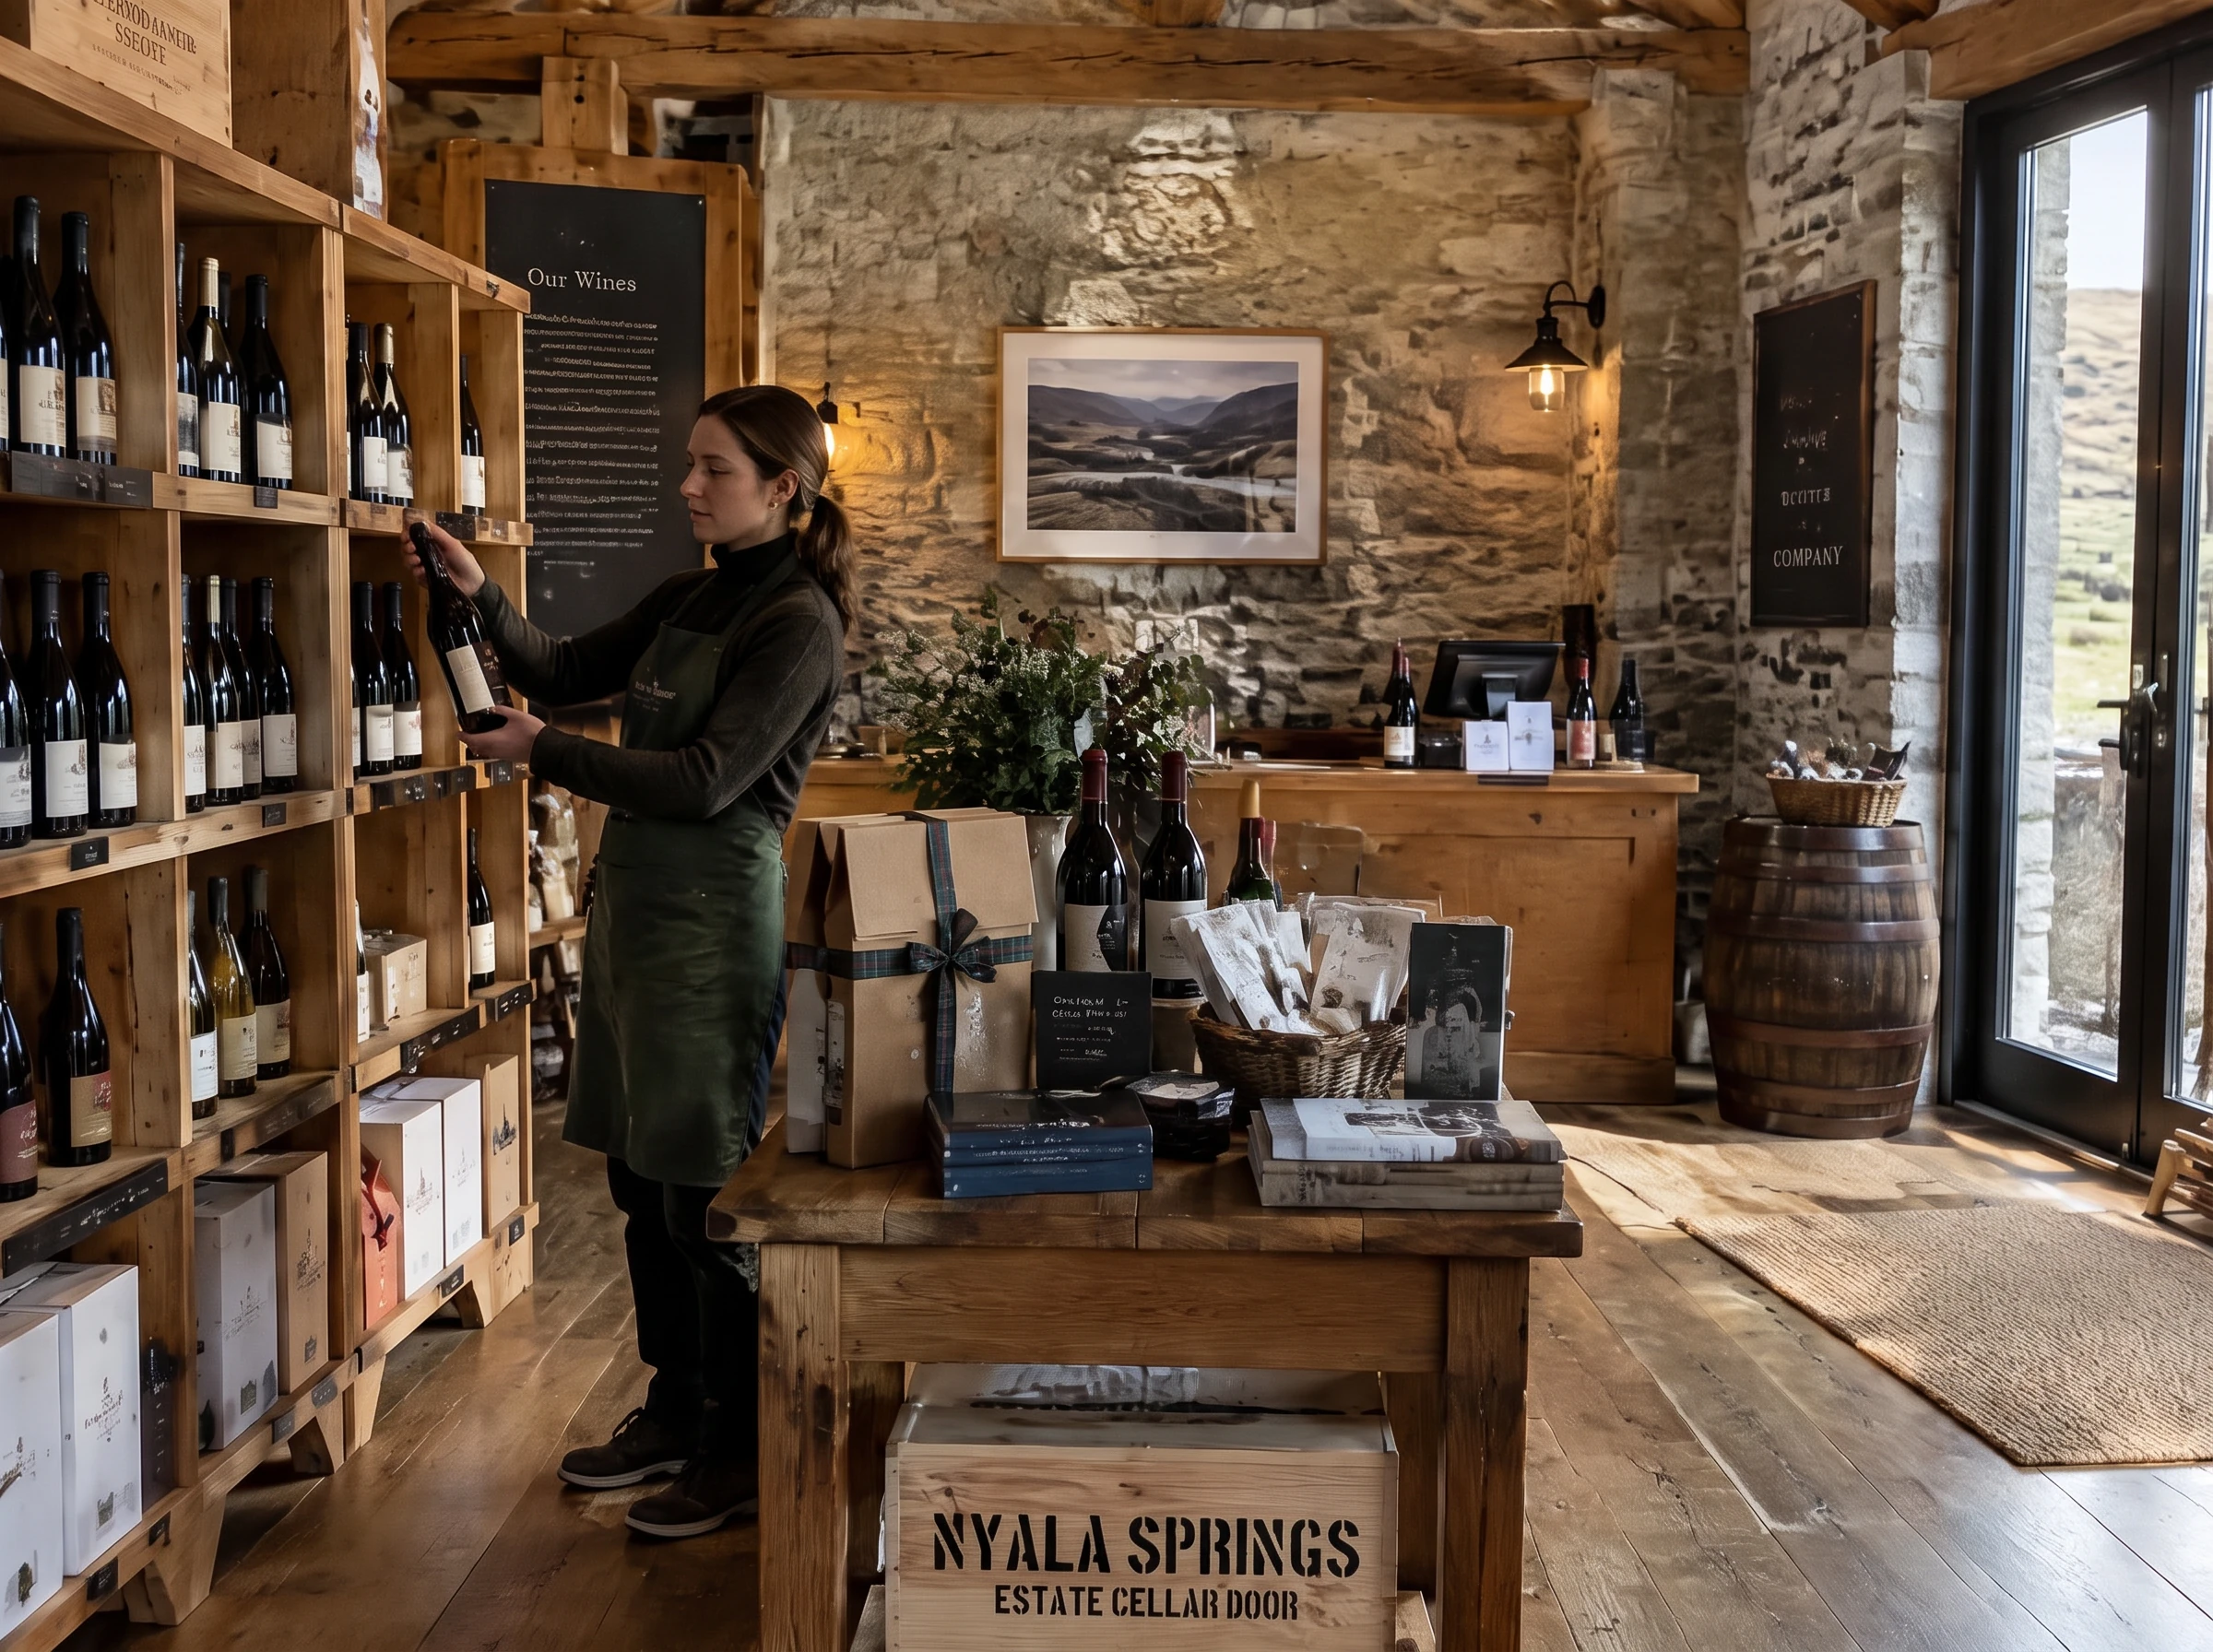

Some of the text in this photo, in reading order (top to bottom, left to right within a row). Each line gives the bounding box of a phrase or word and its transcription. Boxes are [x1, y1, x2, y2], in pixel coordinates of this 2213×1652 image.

[527, 267, 637, 292] Our Wines
[1773, 546, 1843, 567] COMPANY
[933, 1512, 1360, 1578] NYALA SPRINGS
[995, 1584, 1298, 1621] ESTATE CELLAR DOOR
